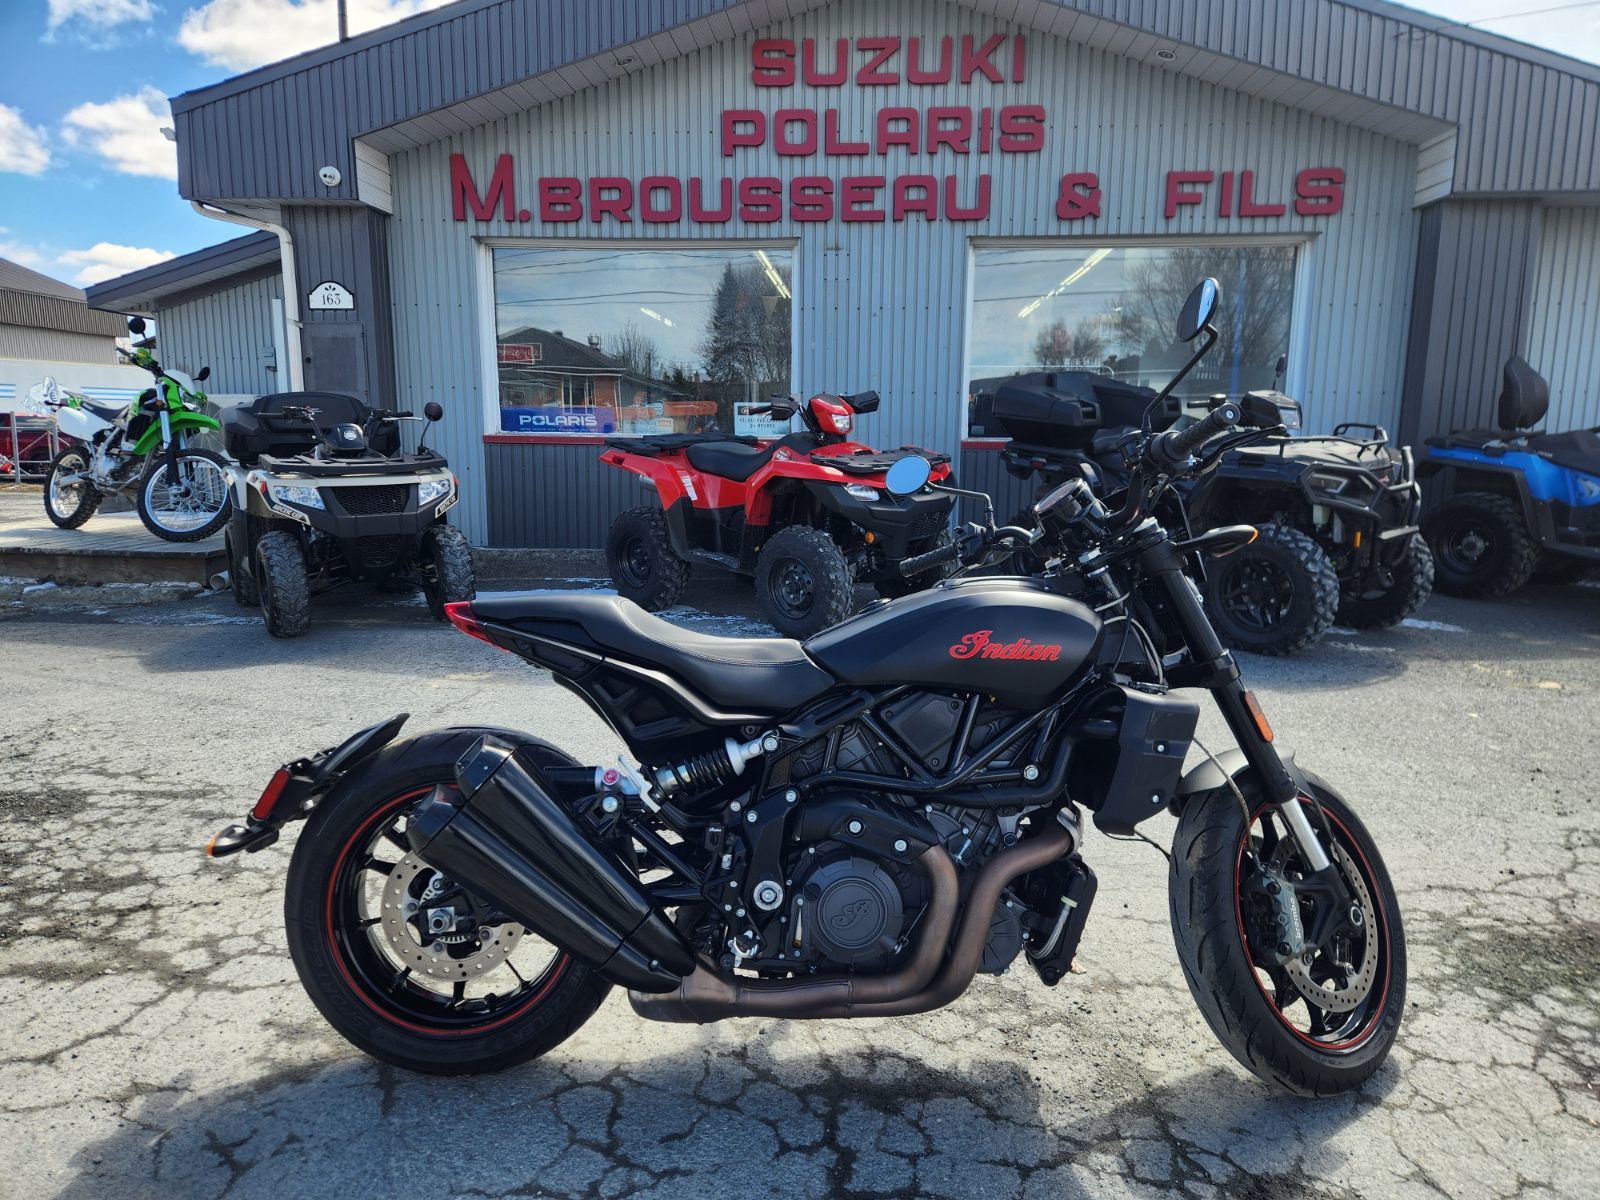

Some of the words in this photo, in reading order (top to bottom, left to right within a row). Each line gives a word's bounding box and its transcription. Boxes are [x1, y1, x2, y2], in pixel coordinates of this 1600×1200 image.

[751, 34, 1025, 88] SUZUKI
[721, 104, 1047, 158] POLARIS
[1055, 171, 1103, 220] &
[1164, 166, 1346, 219] FILS
[322, 293, 341, 305] 163
[519, 415, 598, 427] POLARIS
[949, 629, 1062, 661] Indian
[1290, 897, 1302, 939] brembo
